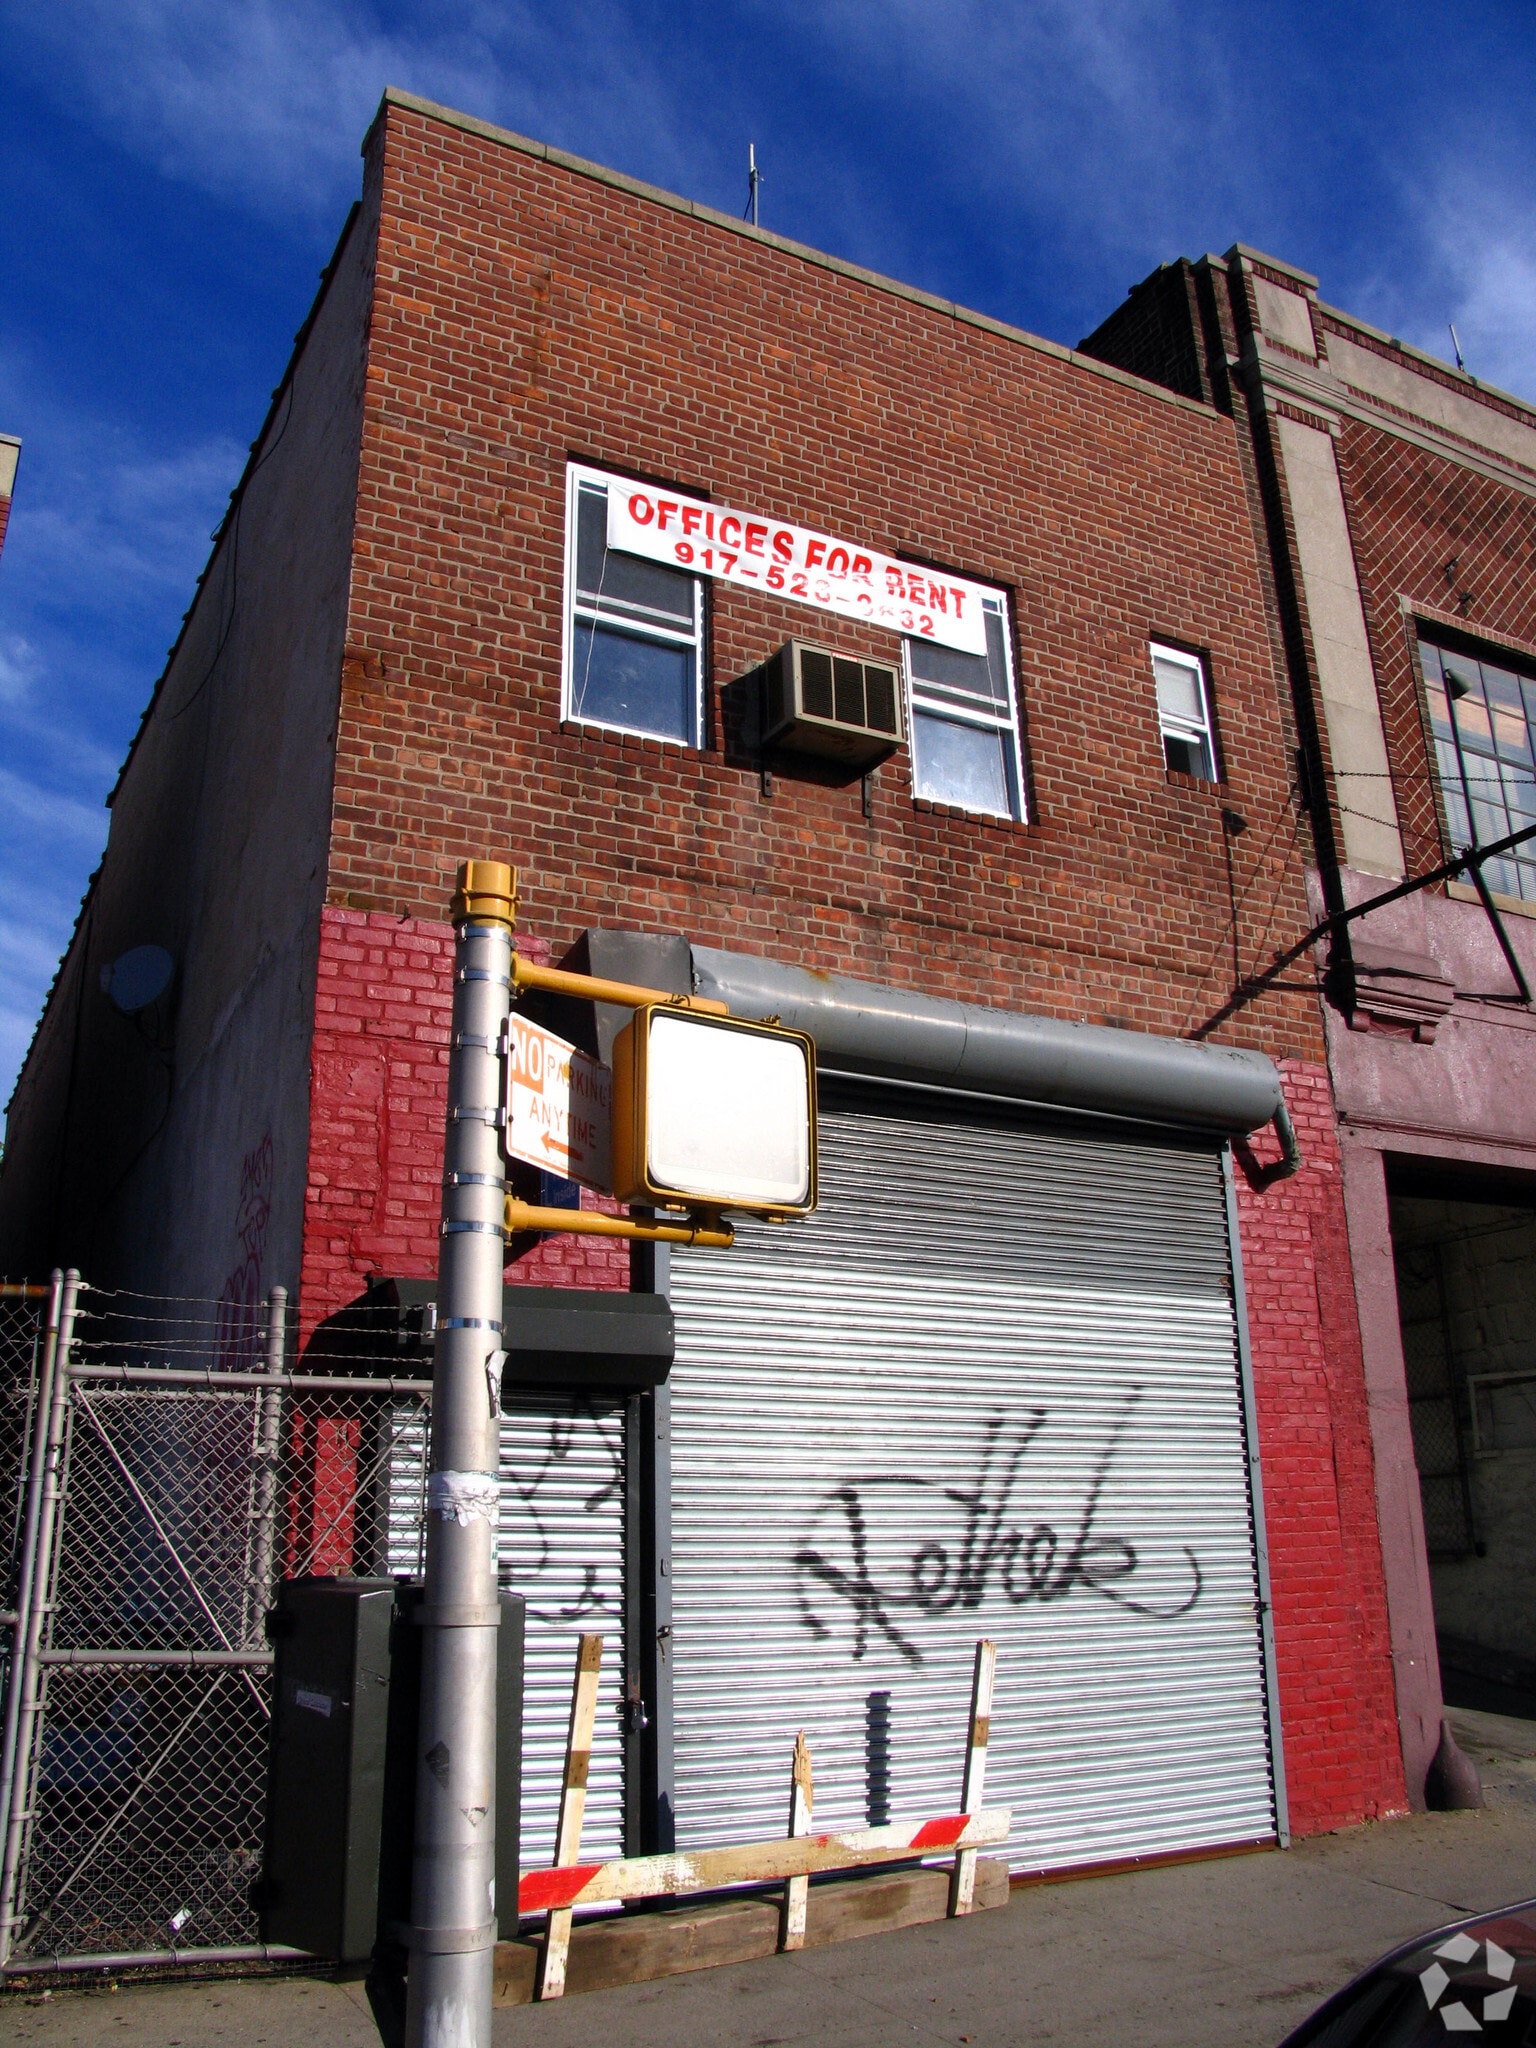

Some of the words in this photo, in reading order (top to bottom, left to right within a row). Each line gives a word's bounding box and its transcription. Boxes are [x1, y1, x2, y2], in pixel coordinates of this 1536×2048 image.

[628, 493, 794, 566] OFFICES
[805, 539, 874, 587] FOR
[885, 565, 967, 618] RENT
[511, 1025, 542, 1082] NO
[547, 1053, 608, 1108] PARKING
[529, 1095, 597, 1149] ANYTIME
